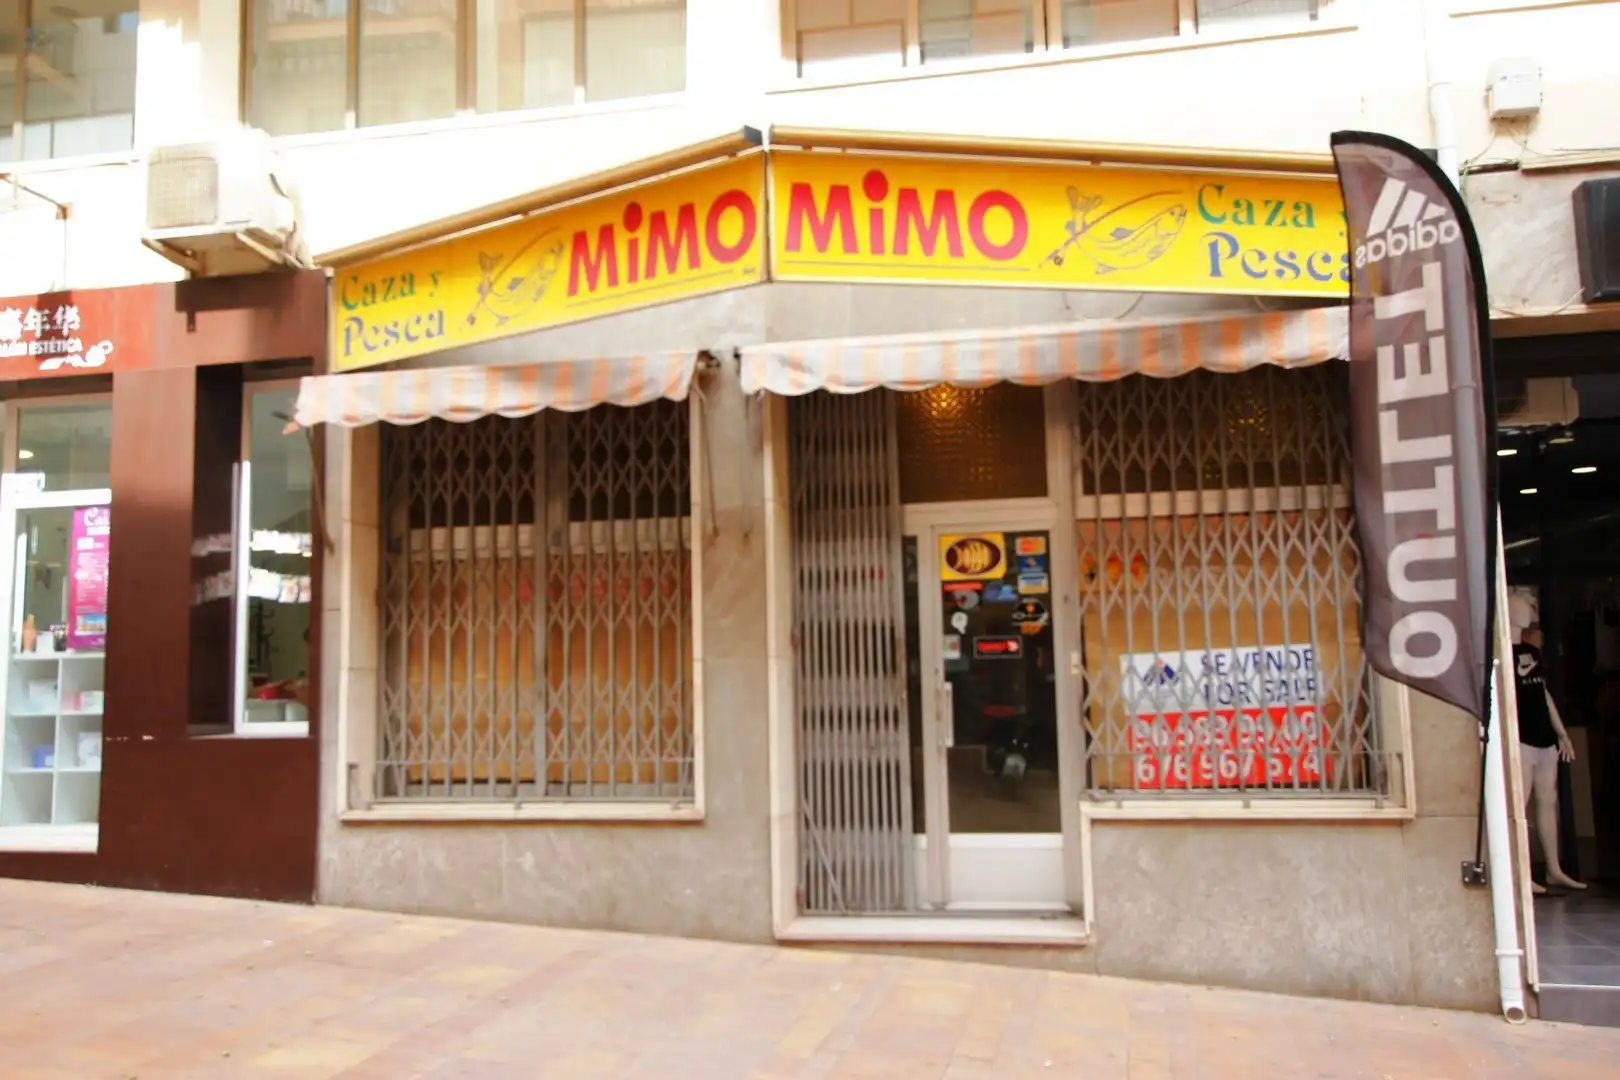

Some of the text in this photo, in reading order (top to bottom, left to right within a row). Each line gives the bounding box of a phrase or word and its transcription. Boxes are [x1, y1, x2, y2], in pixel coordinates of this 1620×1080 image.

[1197, 183, 1315, 228] Caza
[342, 271, 415, 311] Caza
[343, 310, 444, 357] Pesca
